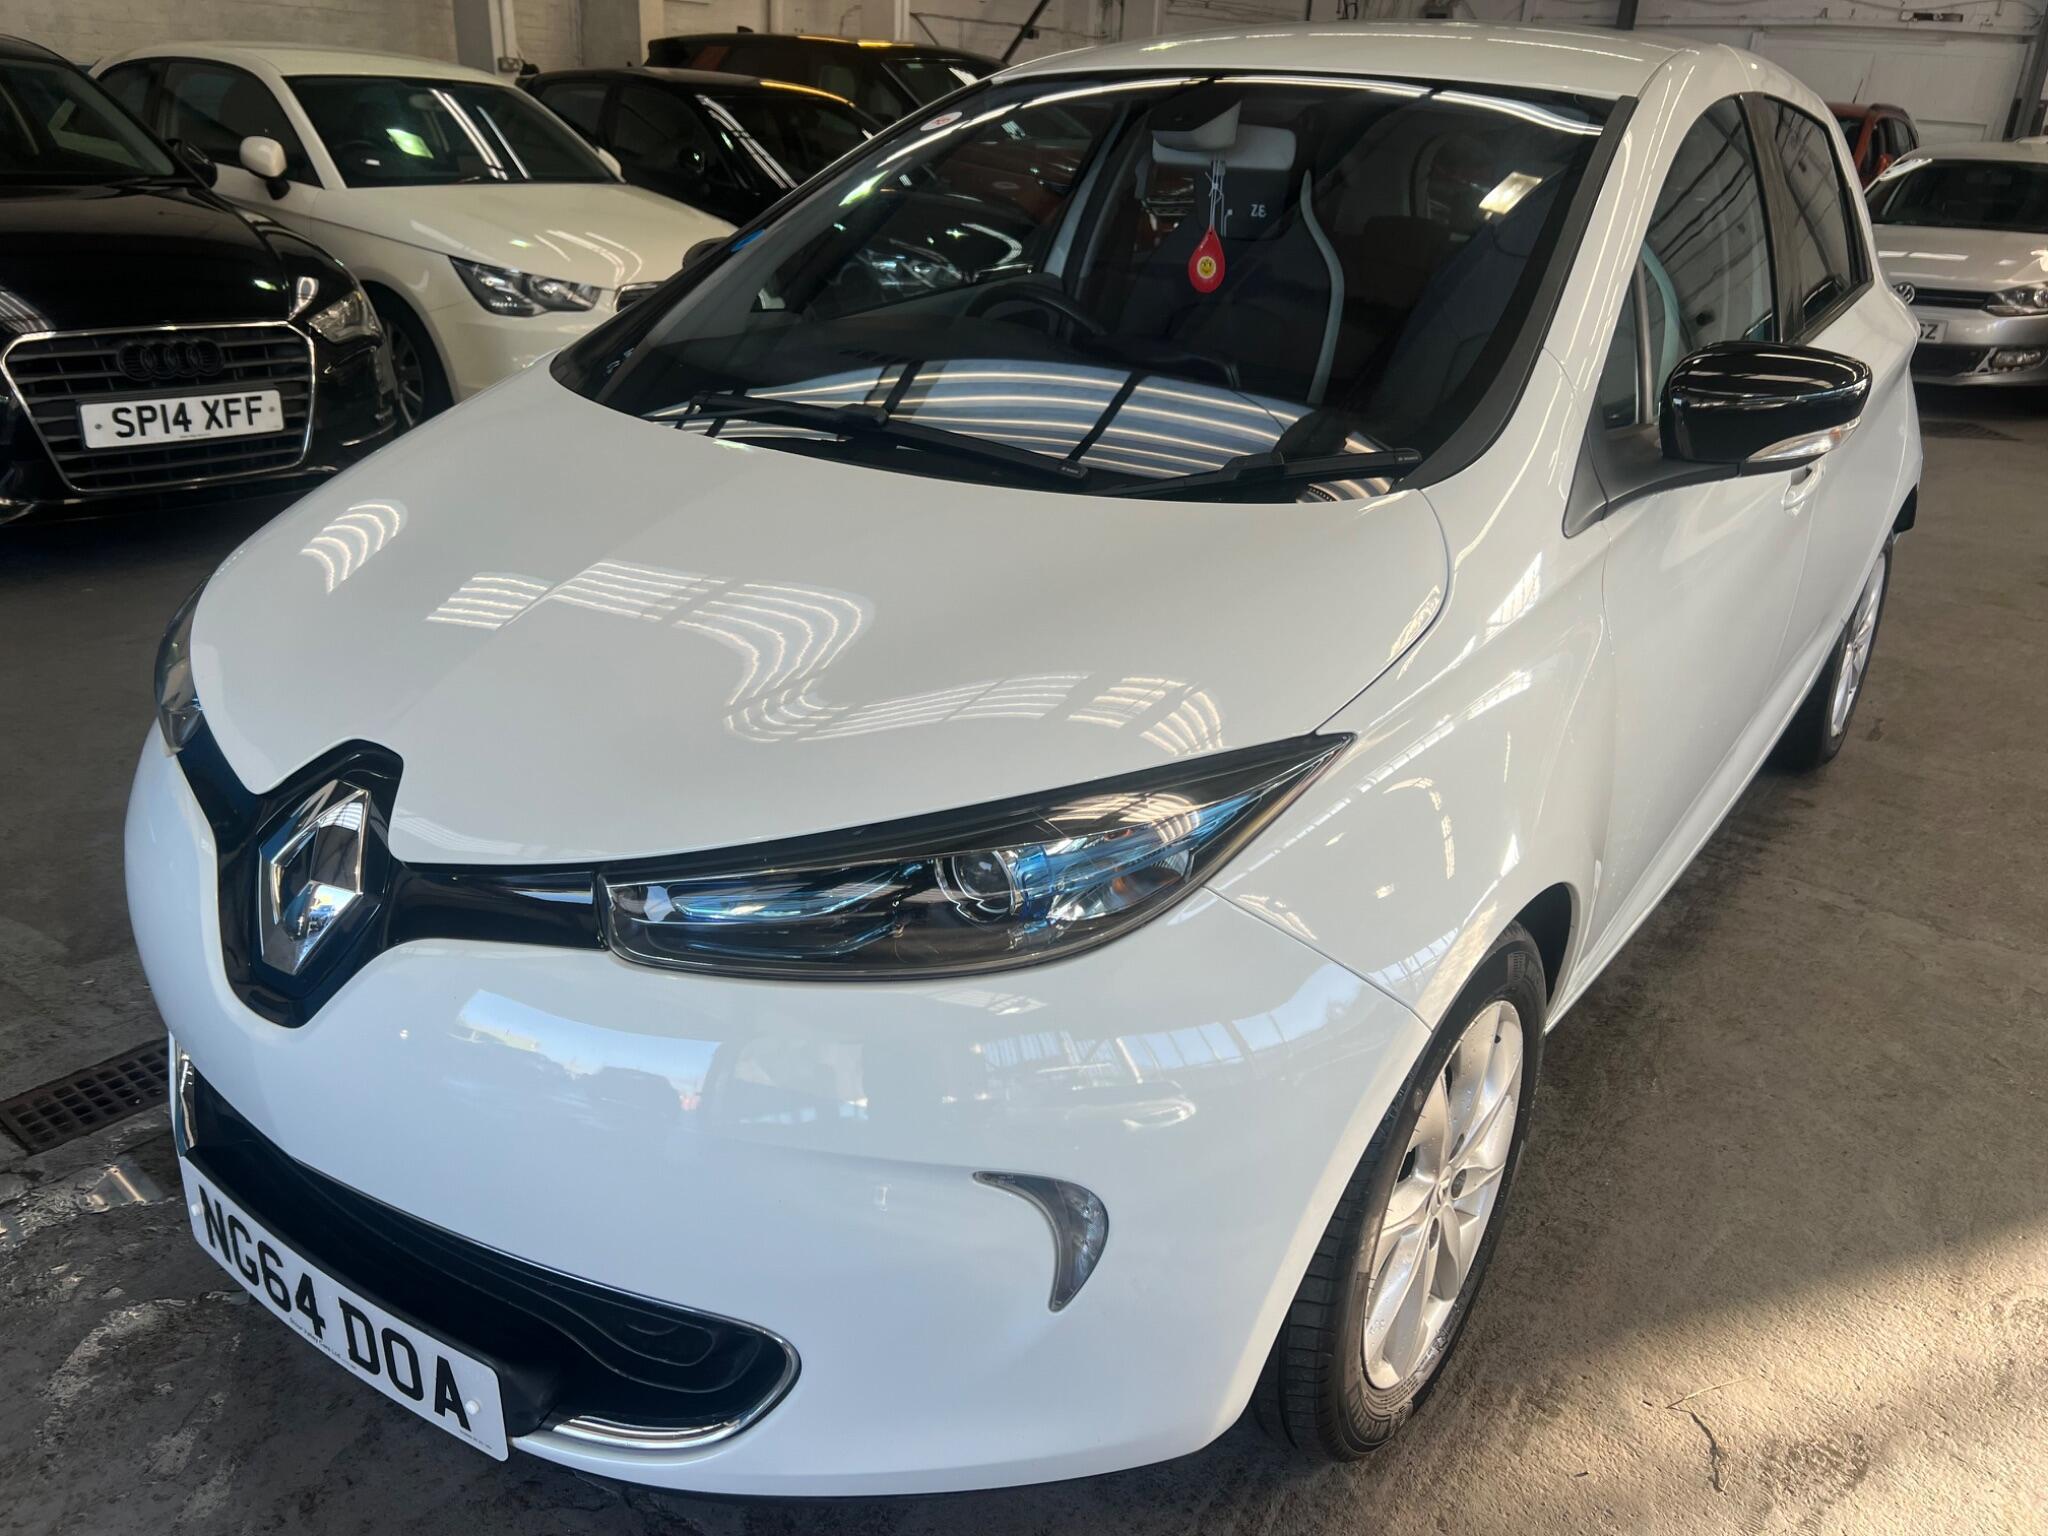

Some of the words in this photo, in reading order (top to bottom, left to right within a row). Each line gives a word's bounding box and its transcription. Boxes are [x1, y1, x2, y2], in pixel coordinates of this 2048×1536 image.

[112, 402, 192, 438] SP14
[201, 396, 262, 430] XFF
[198, 1184, 326, 1339] NG64
[338, 1296, 472, 1432] DOA
